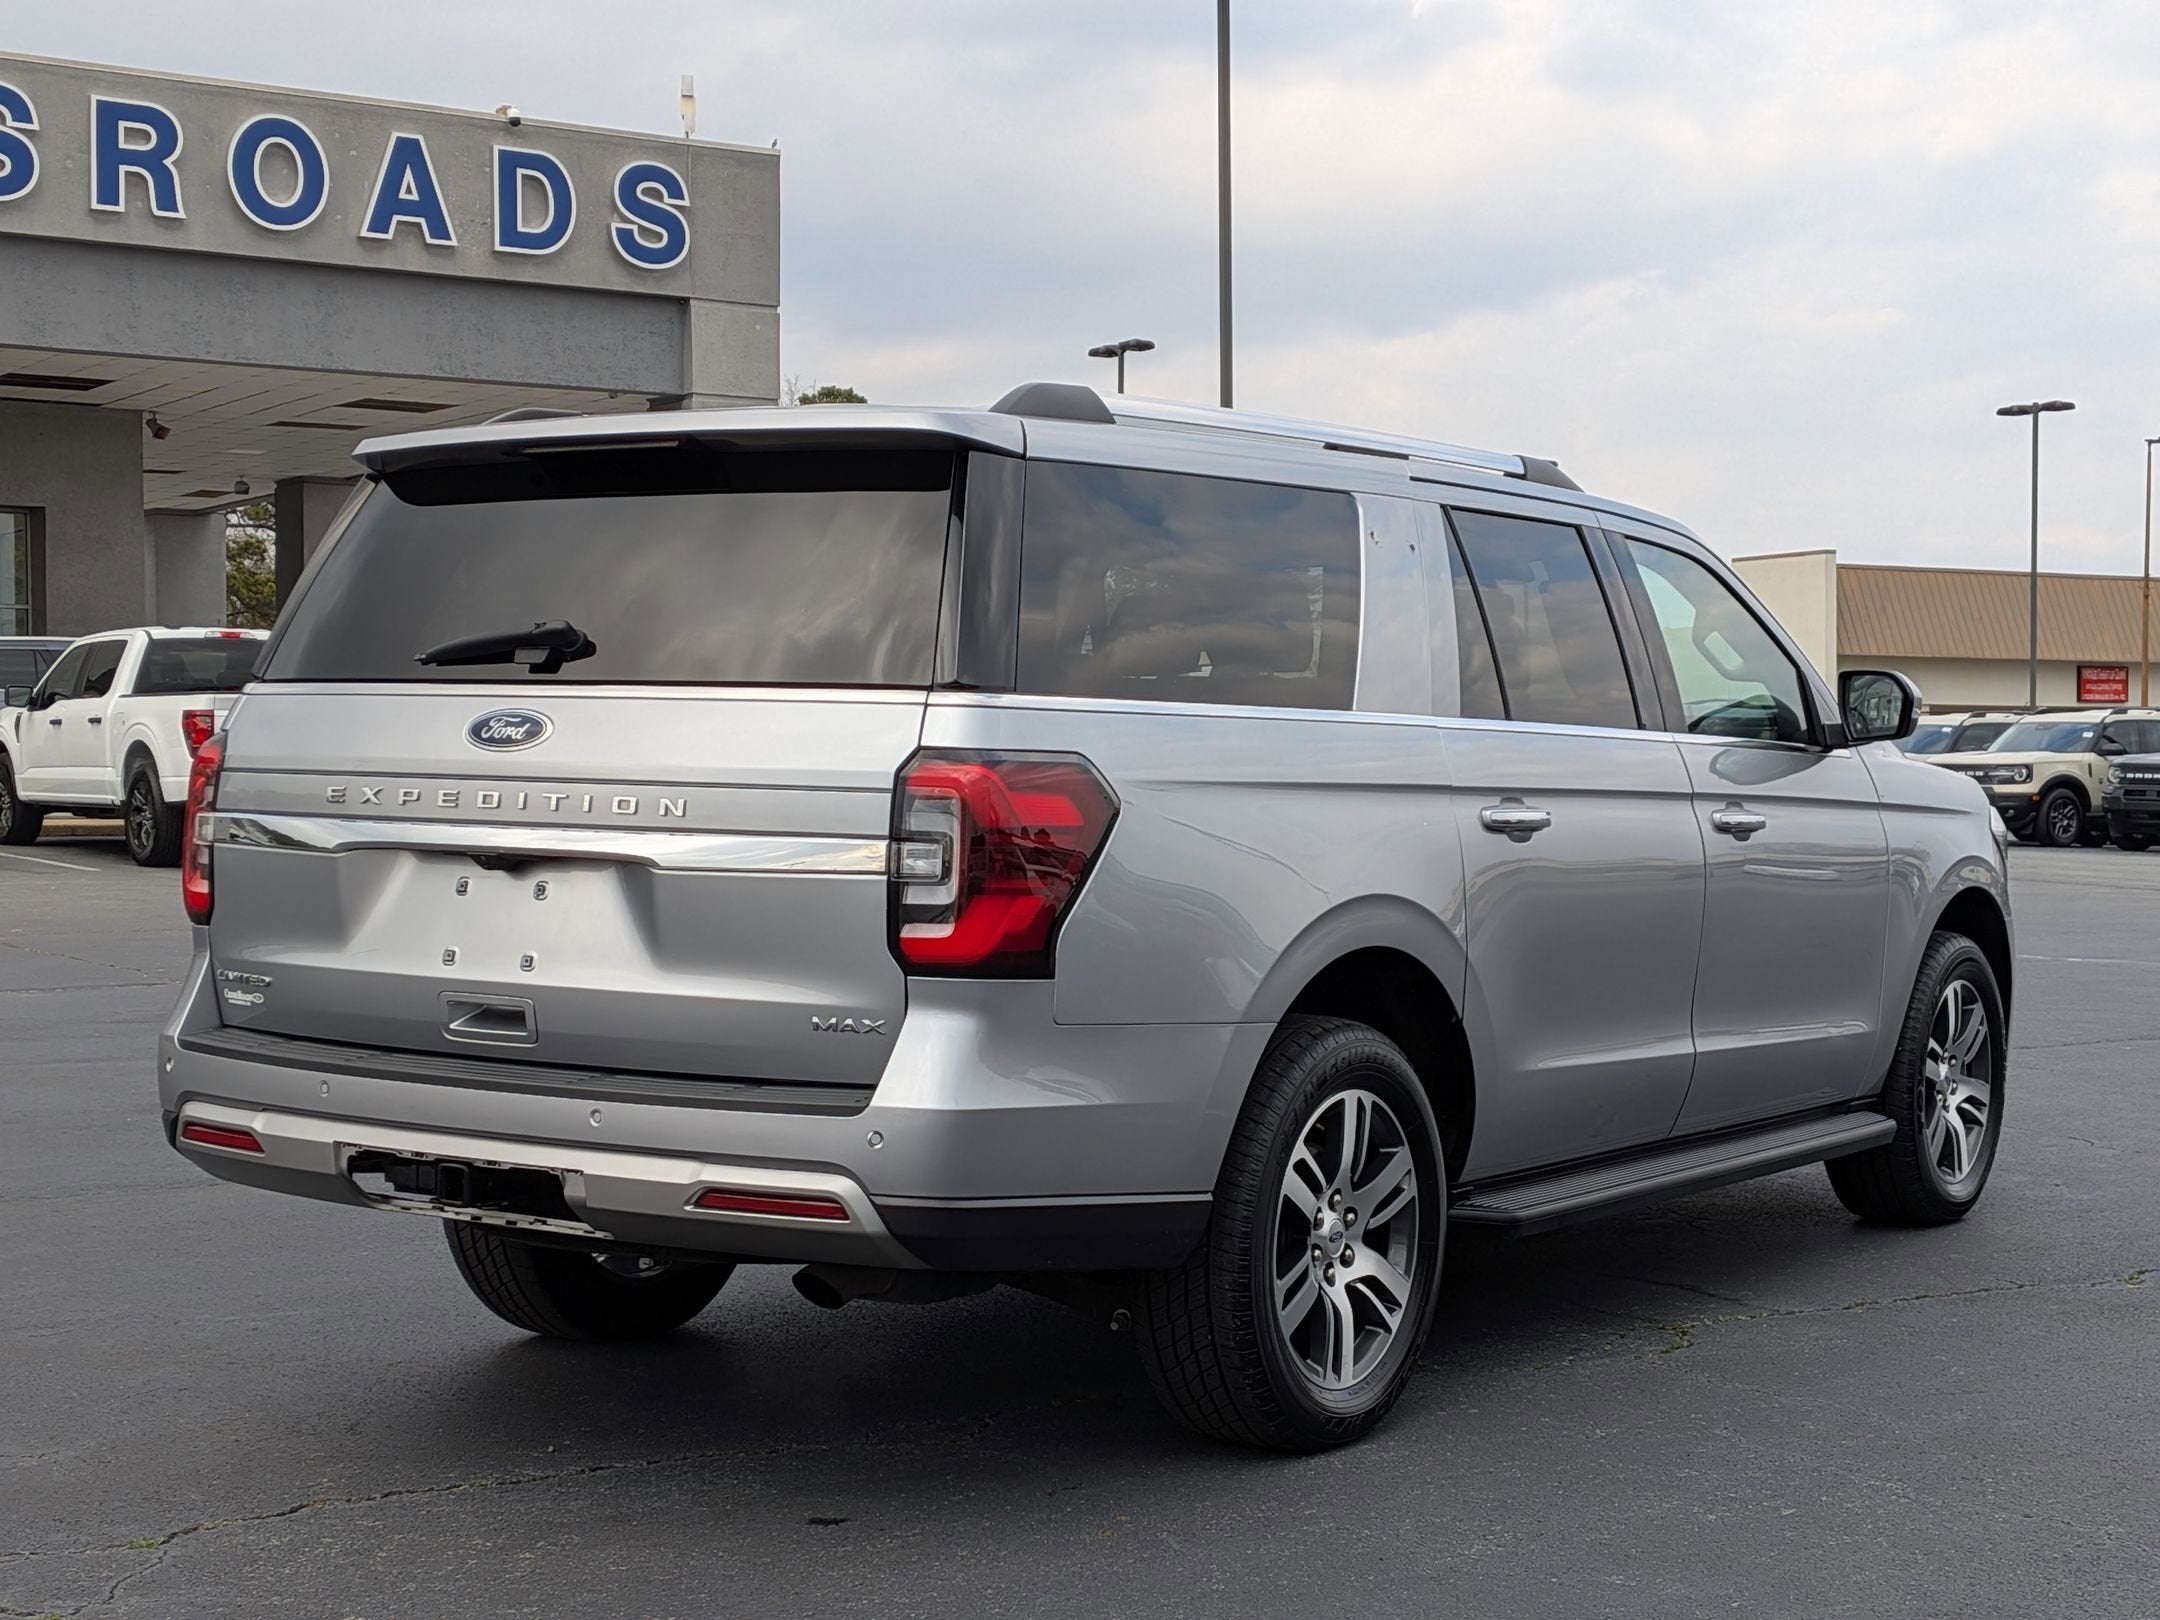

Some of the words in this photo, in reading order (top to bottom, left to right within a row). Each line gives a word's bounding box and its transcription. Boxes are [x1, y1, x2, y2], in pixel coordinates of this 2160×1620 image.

[480, 715, 532, 740] Ford
[326, 785, 686, 818] EXPEDITION
[811, 1015, 887, 1035] MAX
